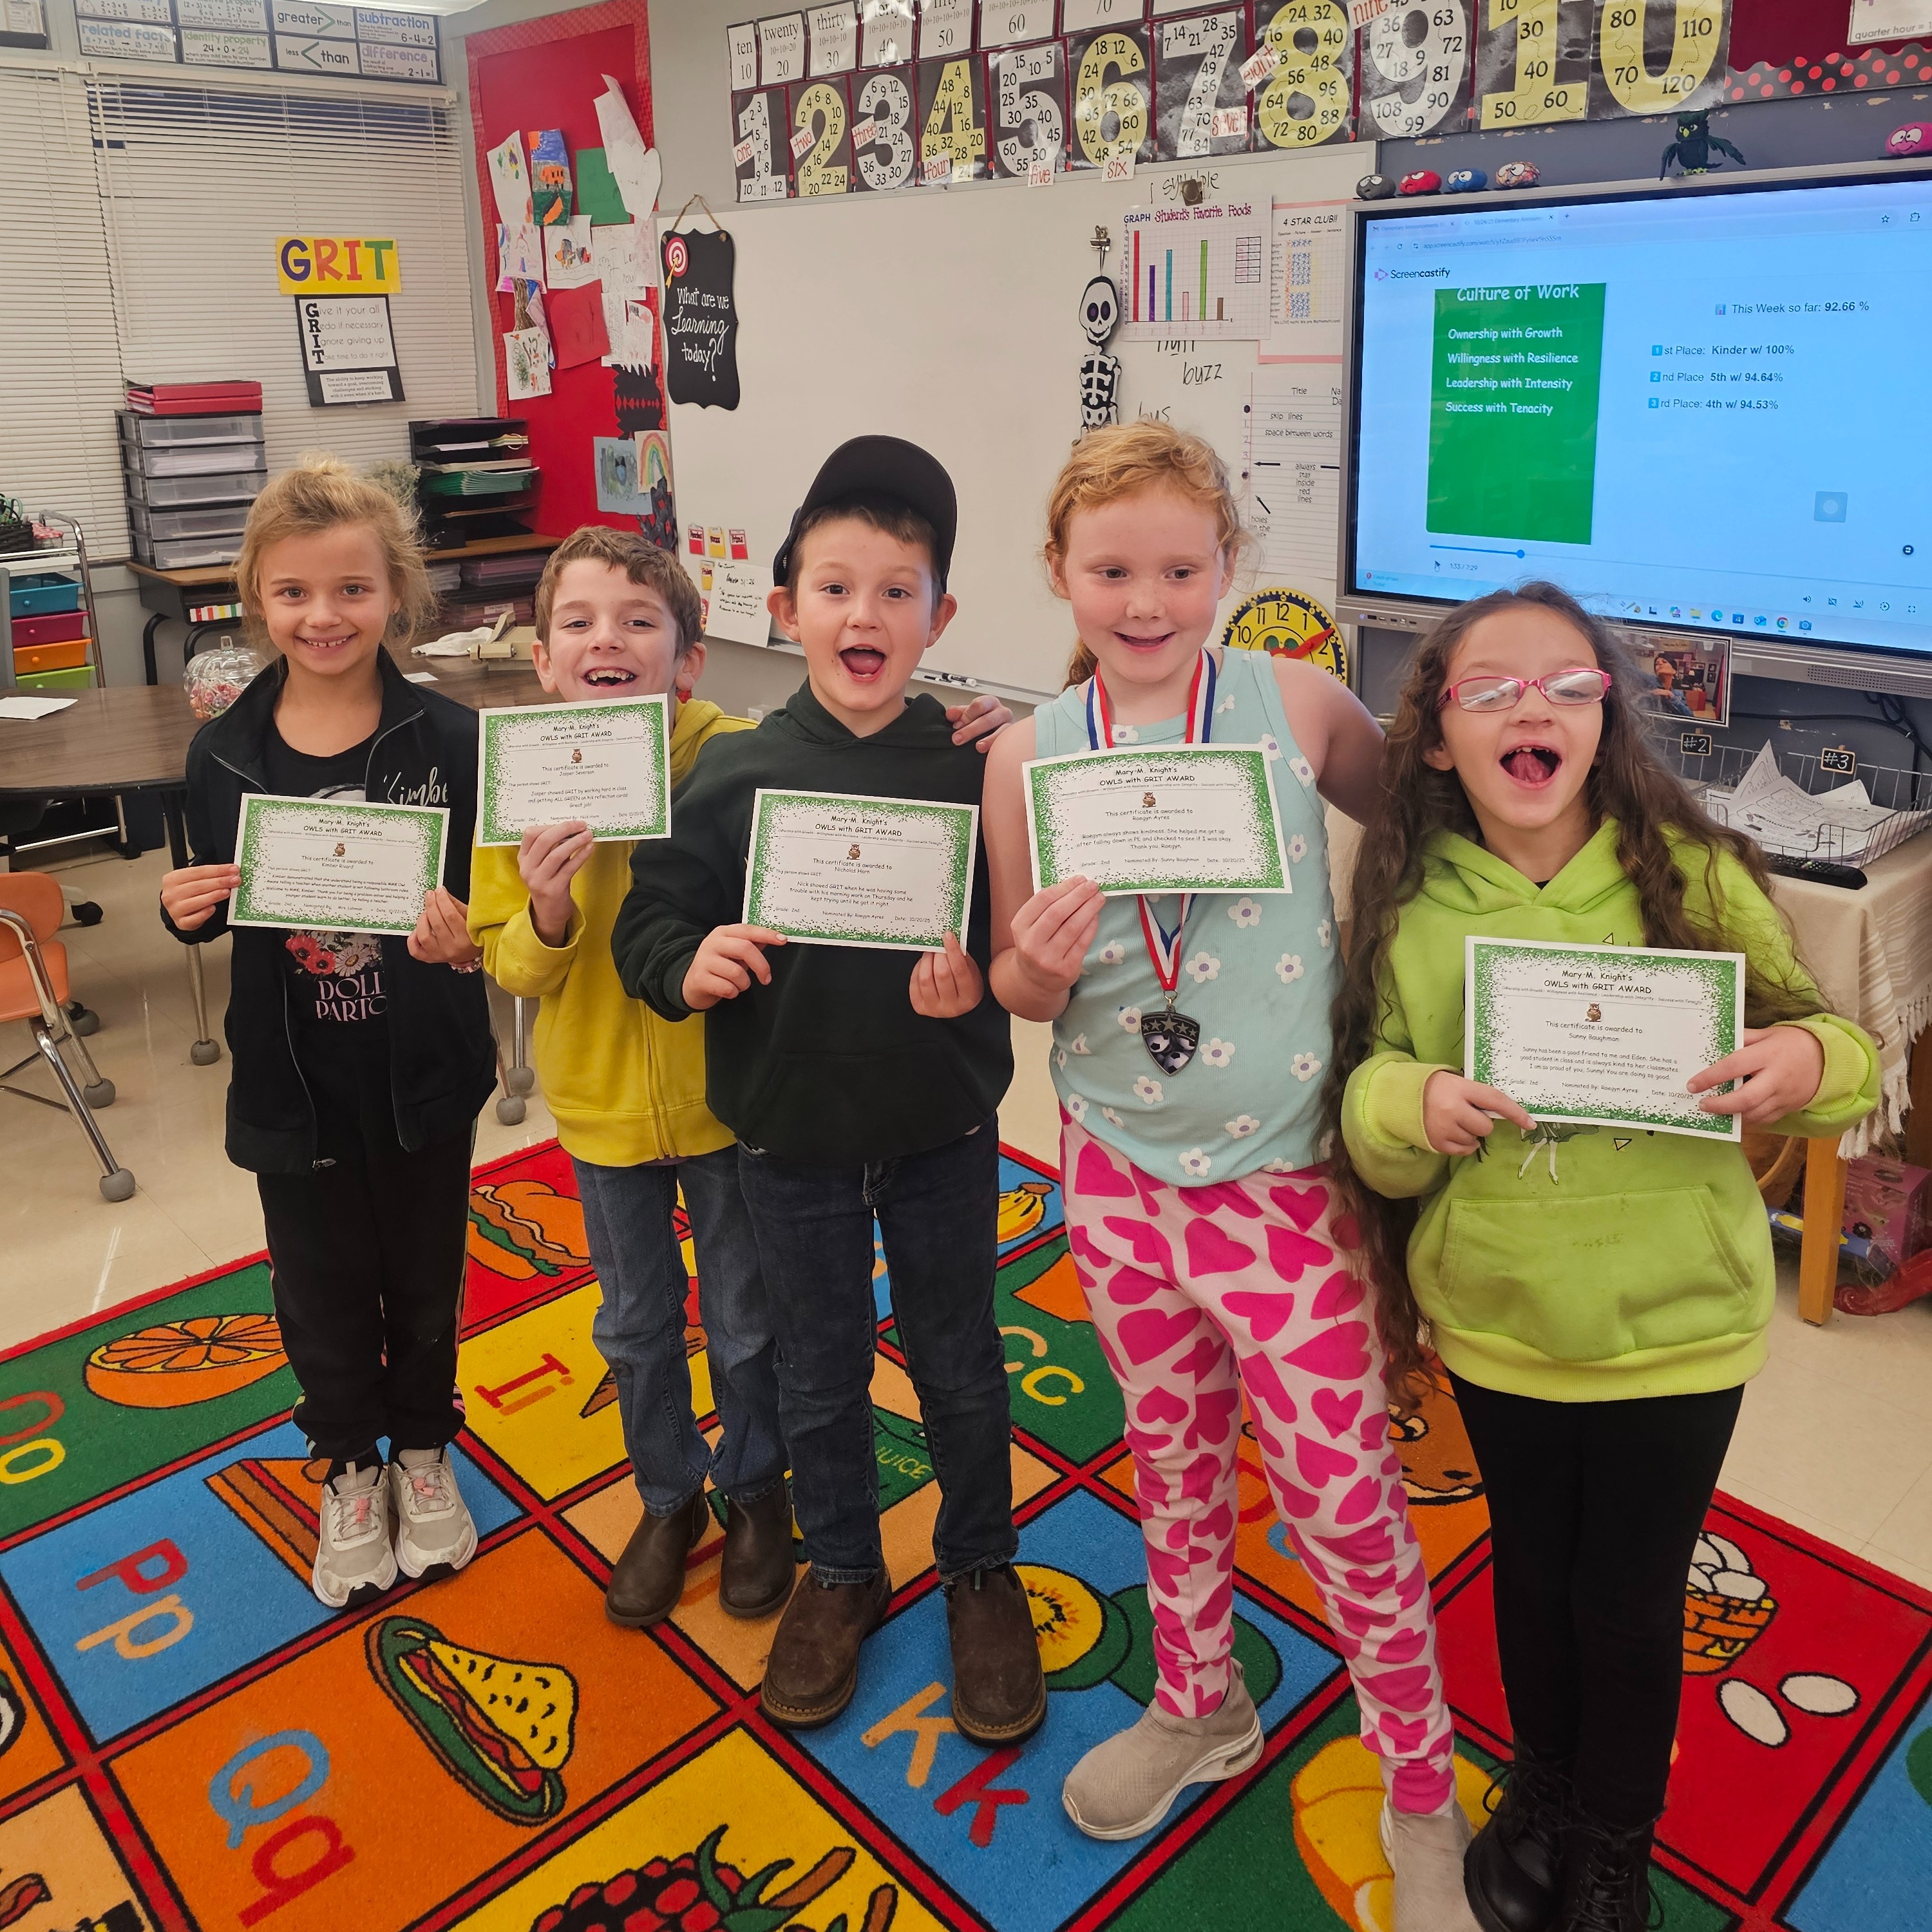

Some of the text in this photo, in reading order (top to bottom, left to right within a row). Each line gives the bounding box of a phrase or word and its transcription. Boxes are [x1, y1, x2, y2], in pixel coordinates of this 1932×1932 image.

[278, 12, 323, 25] greater
[359, 12, 430, 30] subtraction
[817, 12, 847, 30] thirty
[1009, 14, 1025, 33] 60
[764, 22, 799, 45] twenty
[938, 29, 953, 48] 50
[362, 45, 428, 62] difference
[737, 41, 752, 55] ten
[321, 52, 349, 64] than
[826, 51, 839, 68] 30
[1242, 45, 1278, 86] eight
[776, 62, 789, 77] 20
[1212, 111, 1247, 137] seven
[794, 131, 813, 153] two
[853, 122, 876, 146] three
[736, 142, 752, 162] one
[925, 159, 949, 180] four
[1030, 166, 1050, 185] five
[1107, 156, 1127, 178] six
[1124, 213, 1151, 223] GRAPH
[1193, 205, 1222, 220] Favorite
[1228, 203, 1251, 217] Foods
[1291, 217, 1311, 225] STAR
[281, 239, 393, 281] GRIT
[1390, 267, 1450, 279] Screencastify
[677, 287, 729, 309] What are we
[1457, 284, 1579, 301] Culture of Work
[305, 303, 333, 317] Give
[346, 307, 365, 316] your
[369, 304, 380, 314] all
[1732, 301, 1870, 314] This Week so far: 92.66 %
[309, 319, 336, 332] Redo
[671, 306, 729, 355] Learning
[1448, 327, 1563, 341] Ownership with Growth
[312, 334, 384, 348] Ignore giving up
[1712, 346, 1747, 354] Kinder
[1750, 345, 1762, 354] w/
[1766, 345, 1794, 354] 100%
[681, 337, 716, 381] today?
[1448, 352, 1578, 366] Willingness with Resilience
[1183, 363, 1222, 384] buzz
[1710, 373, 1726, 381] 5th
[1730, 373, 1741, 381] w/
[1745, 373, 1783, 382] 94.64%
[1446, 377, 1573, 392] Leadership with Intensity
[1445, 402, 1553, 416] Success with Tenacity
[1673, 399, 1702, 408] Place:
[1705, 399, 1722, 408] 4th
[1725, 400, 1737, 408] w/
[1740, 400, 1778, 409] 94.53%
[1256, 607, 1265, 625] 11
[1276, 602, 1289, 621] 12
[1302, 612, 1308, 630] 1
[1236, 625, 1251, 644] 10
[1683, 737, 1707, 752] #2
[1824, 752, 1850, 769] #3
[862, 817, 887, 826] Knight's
[1562, 971, 1581, 979] Mary
[1600, 972, 1633, 982] Knight's
[1618, 985, 1651, 994] AWARD
[1560, 1022, 1595, 1031] certificate
[1569, 1033, 1619, 1043] Sunny Baughman
[75, 1538, 194, 1660] Pp
